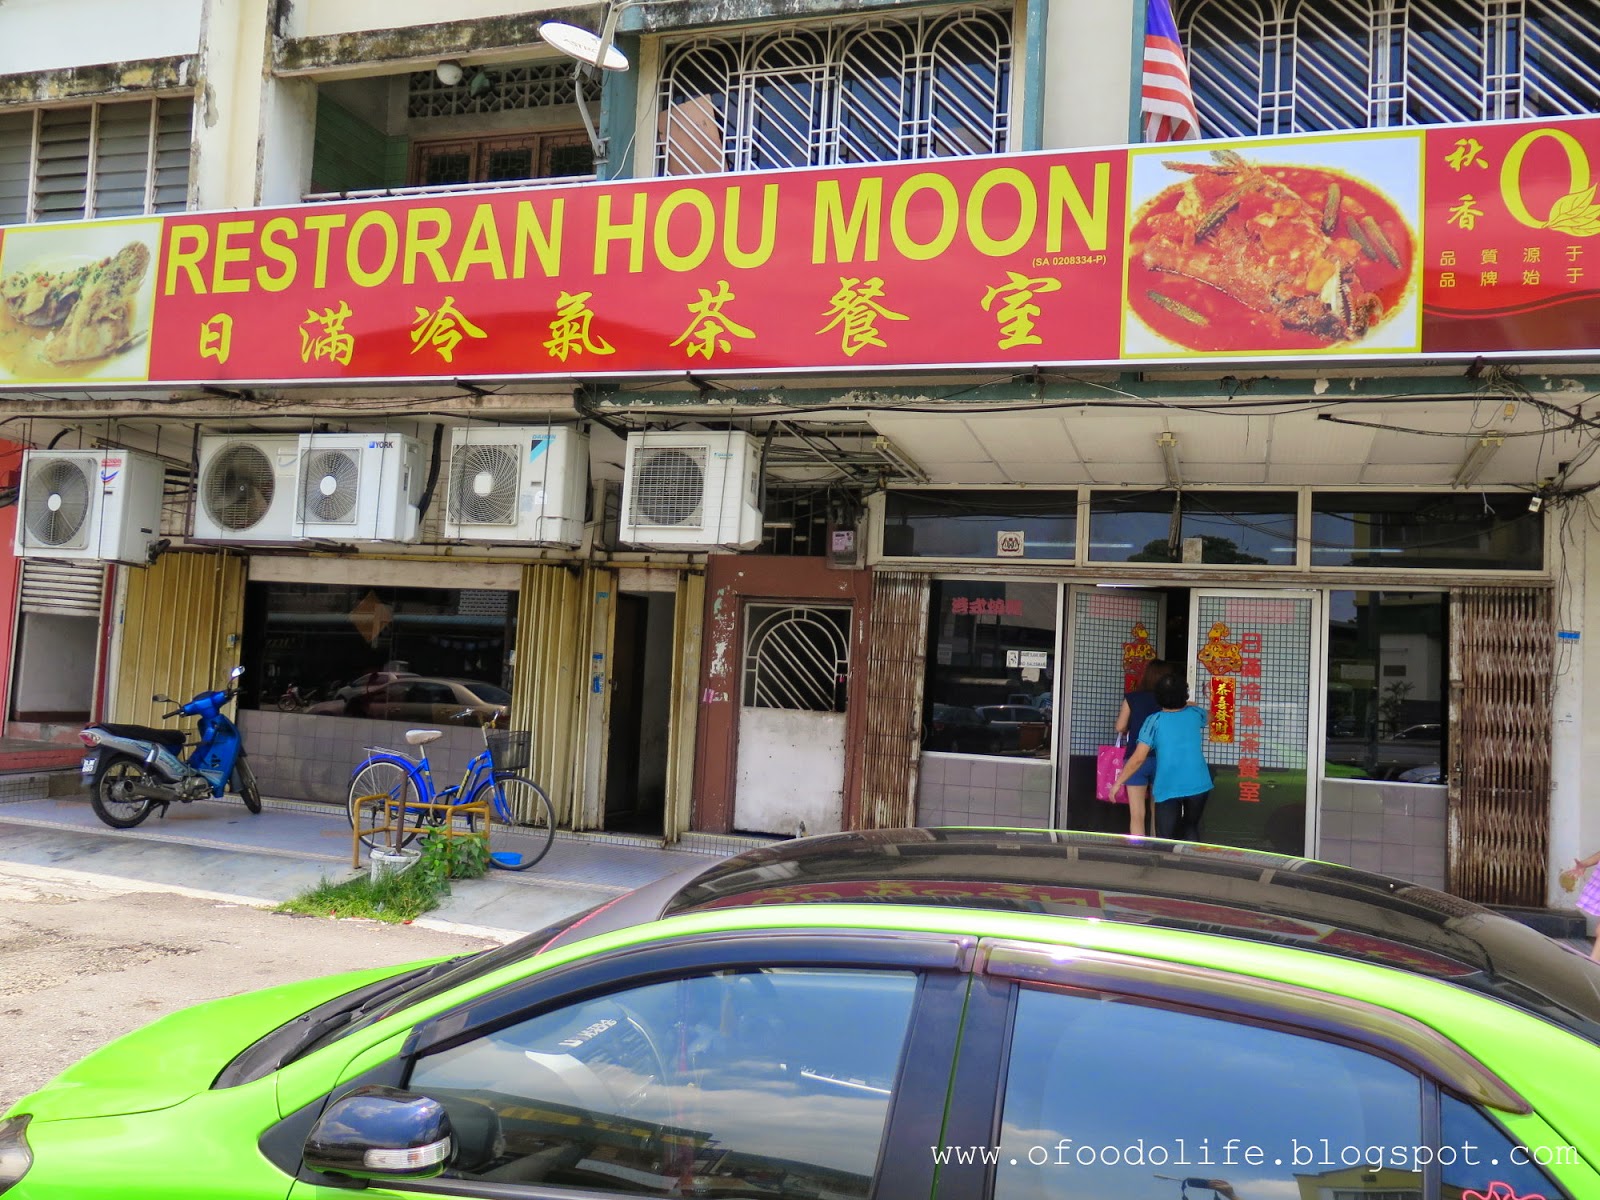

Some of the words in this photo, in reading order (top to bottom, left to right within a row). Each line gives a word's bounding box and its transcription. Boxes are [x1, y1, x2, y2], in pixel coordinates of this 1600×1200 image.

[165, 198, 565, 296] RESTORAN
[594, 184, 778, 275] HOU
[811, 162, 1110, 266] MOON
[1444, 138, 1489, 231] 秋香
[1032, 257, 1050, 268] (SA
[1052, 255, 1107, 266] 0208334-P)
[199, 271, 1062, 366] 日滿冷氣茶餐室
[375, 441, 394, 449] YORK
